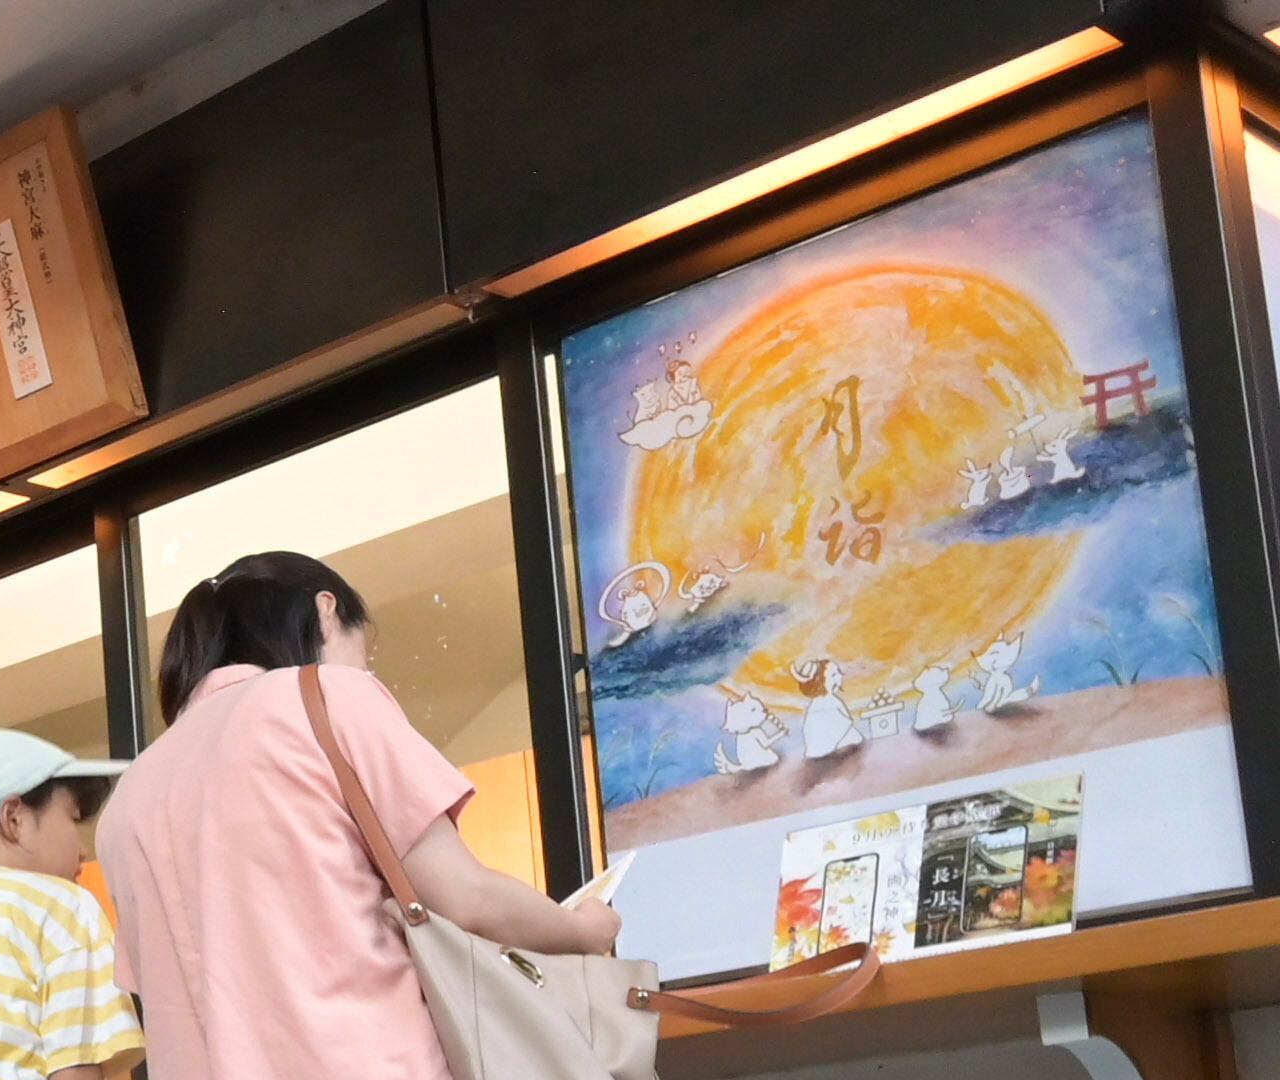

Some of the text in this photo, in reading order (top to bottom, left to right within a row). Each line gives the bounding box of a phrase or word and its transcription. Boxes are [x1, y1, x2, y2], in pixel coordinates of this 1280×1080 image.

[17, 168, 49, 241] 神宮大麻
[818, 374, 886, 567] 月詣
